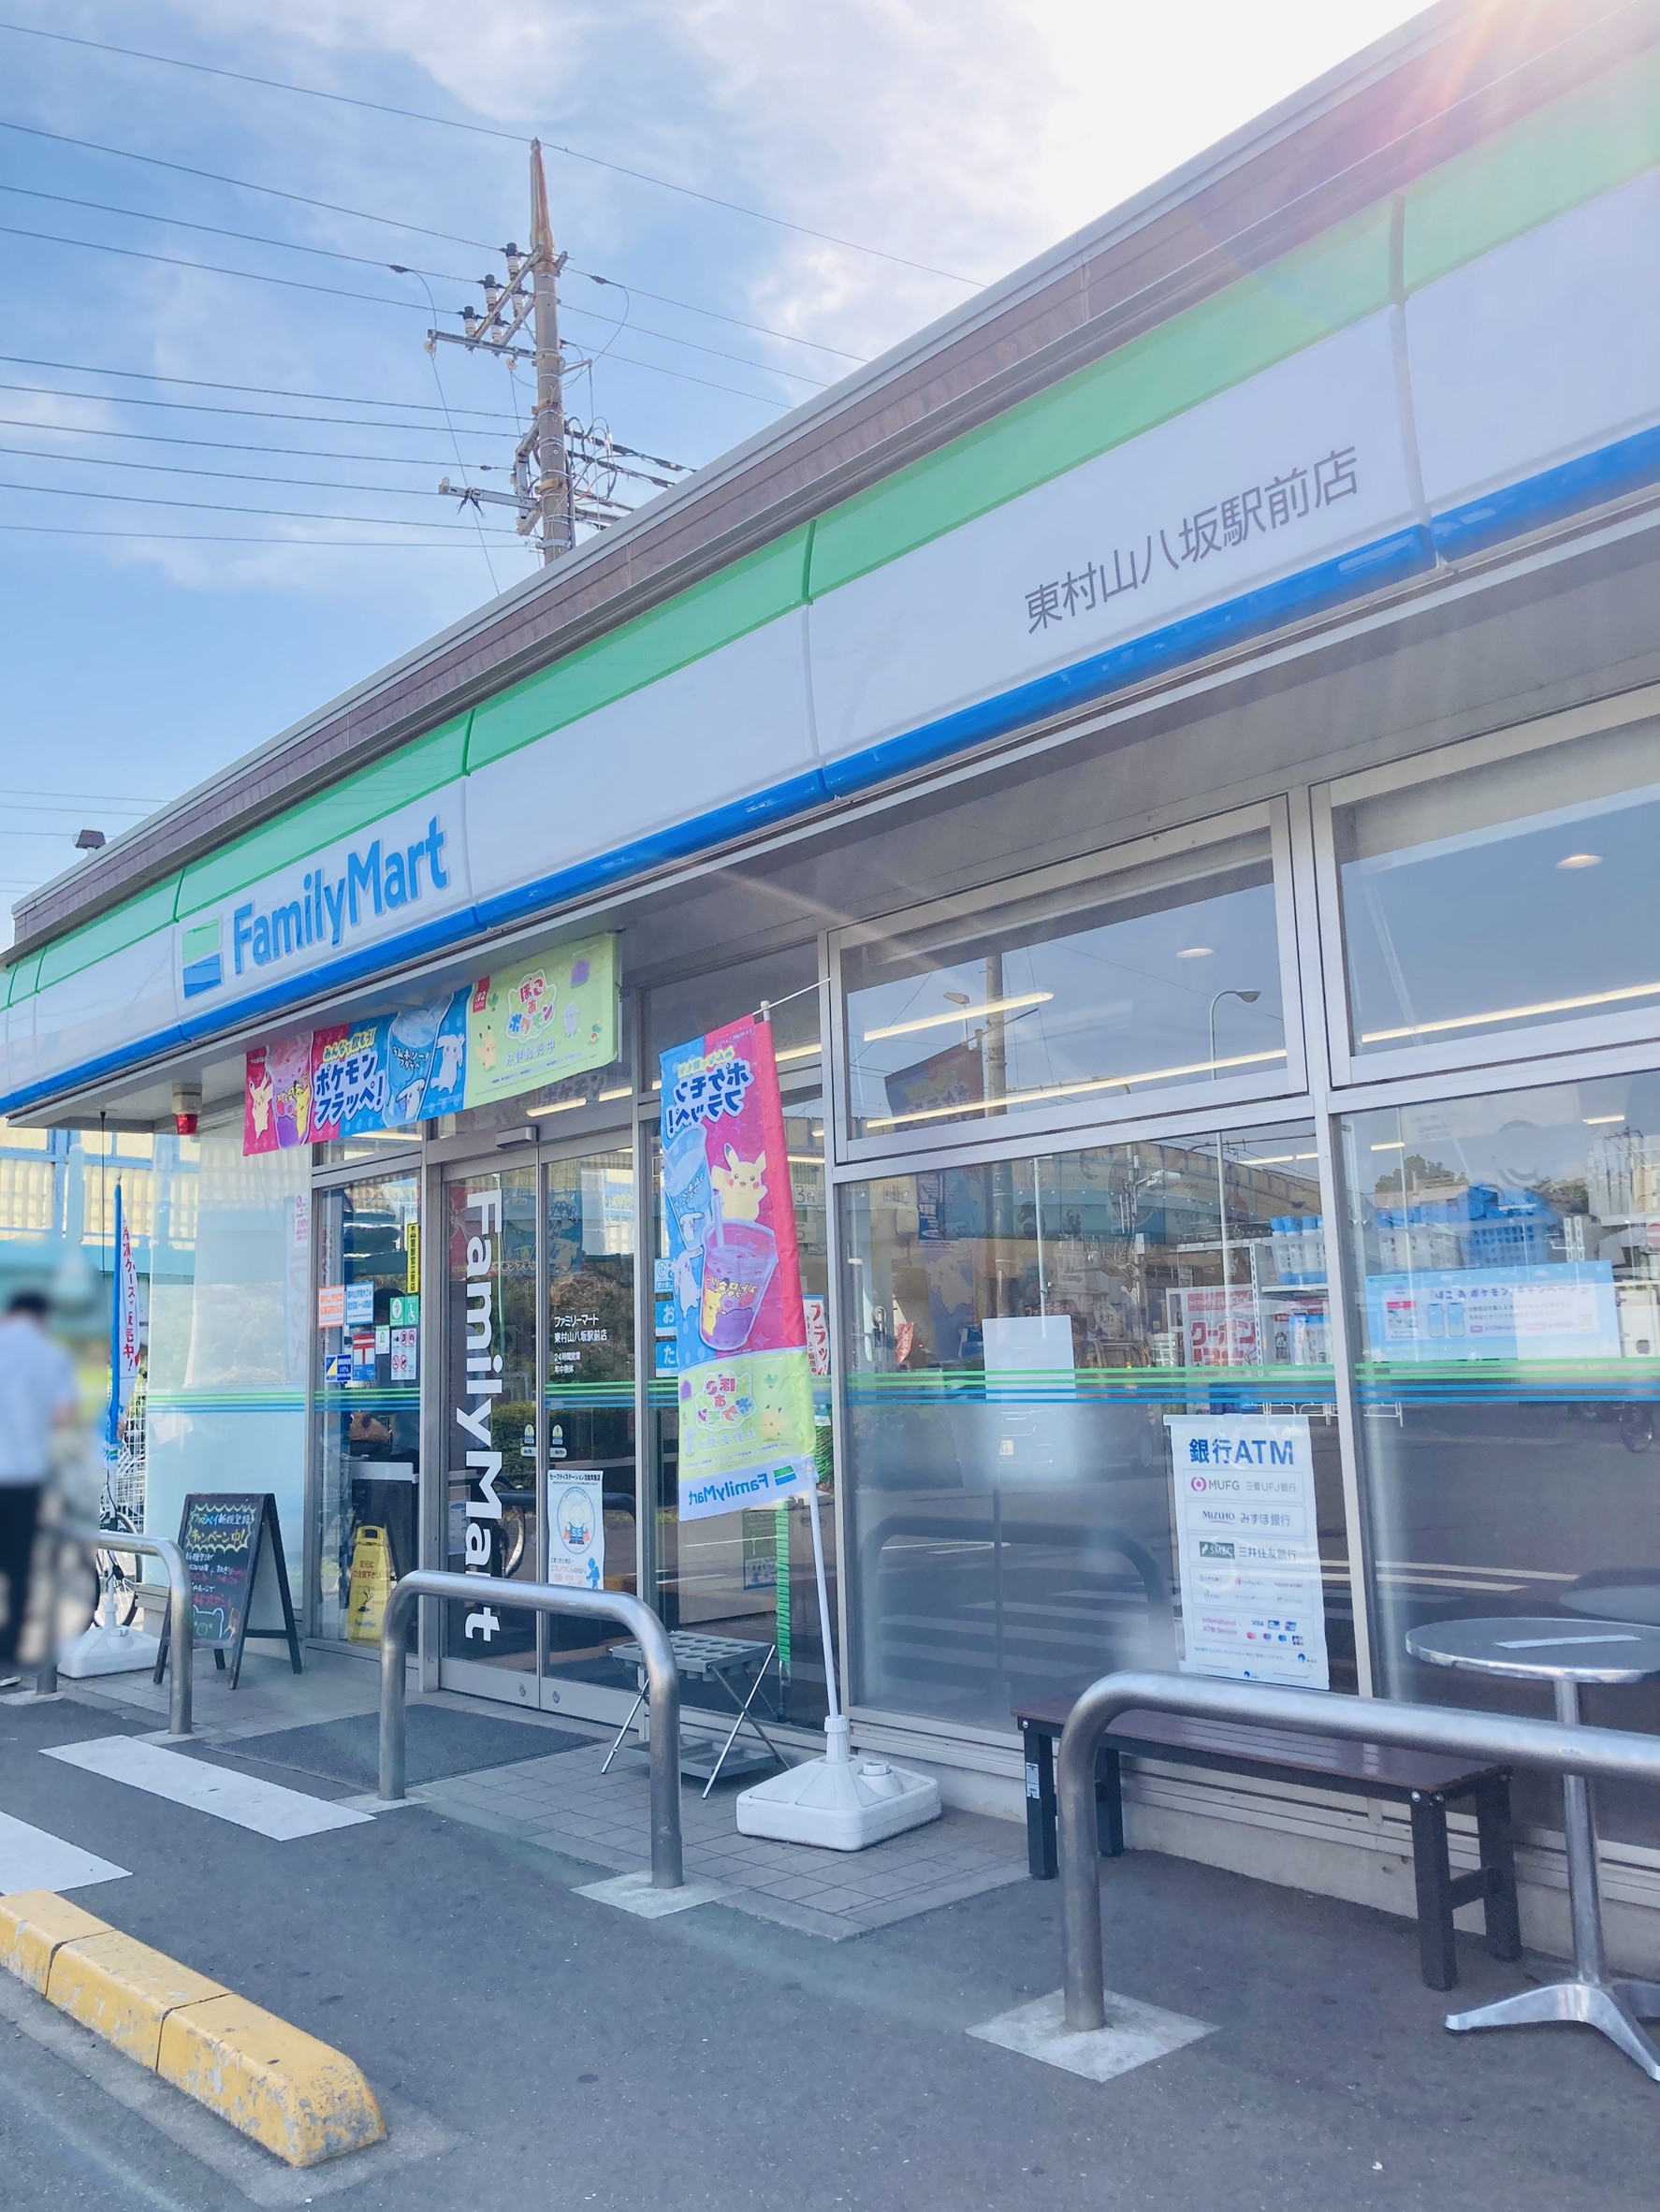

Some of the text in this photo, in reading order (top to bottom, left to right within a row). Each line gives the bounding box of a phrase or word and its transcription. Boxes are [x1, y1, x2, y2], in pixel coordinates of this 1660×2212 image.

[1025, 445, 1358, 634] 東村山八坂駅前店
[233, 815, 448, 975] FamilyMart
[316, 1053, 376, 1097] ポケモン
[316, 1076, 384, 1124] フラッペ!
[554, 1314, 599, 1328] ファミリーマート
[554, 1329, 607, 1344] 東村山八坂駅前店
[1188, 1438, 1294, 1465] 銀行ATM
[1208, 1480, 1296, 1492] MUFG 三菱UFJ銀行
[1202, 1510, 1290, 1527] MIZUHO みずほ銀行
[1210, 1544, 1296, 1561] SMBC 三井住友銀行
